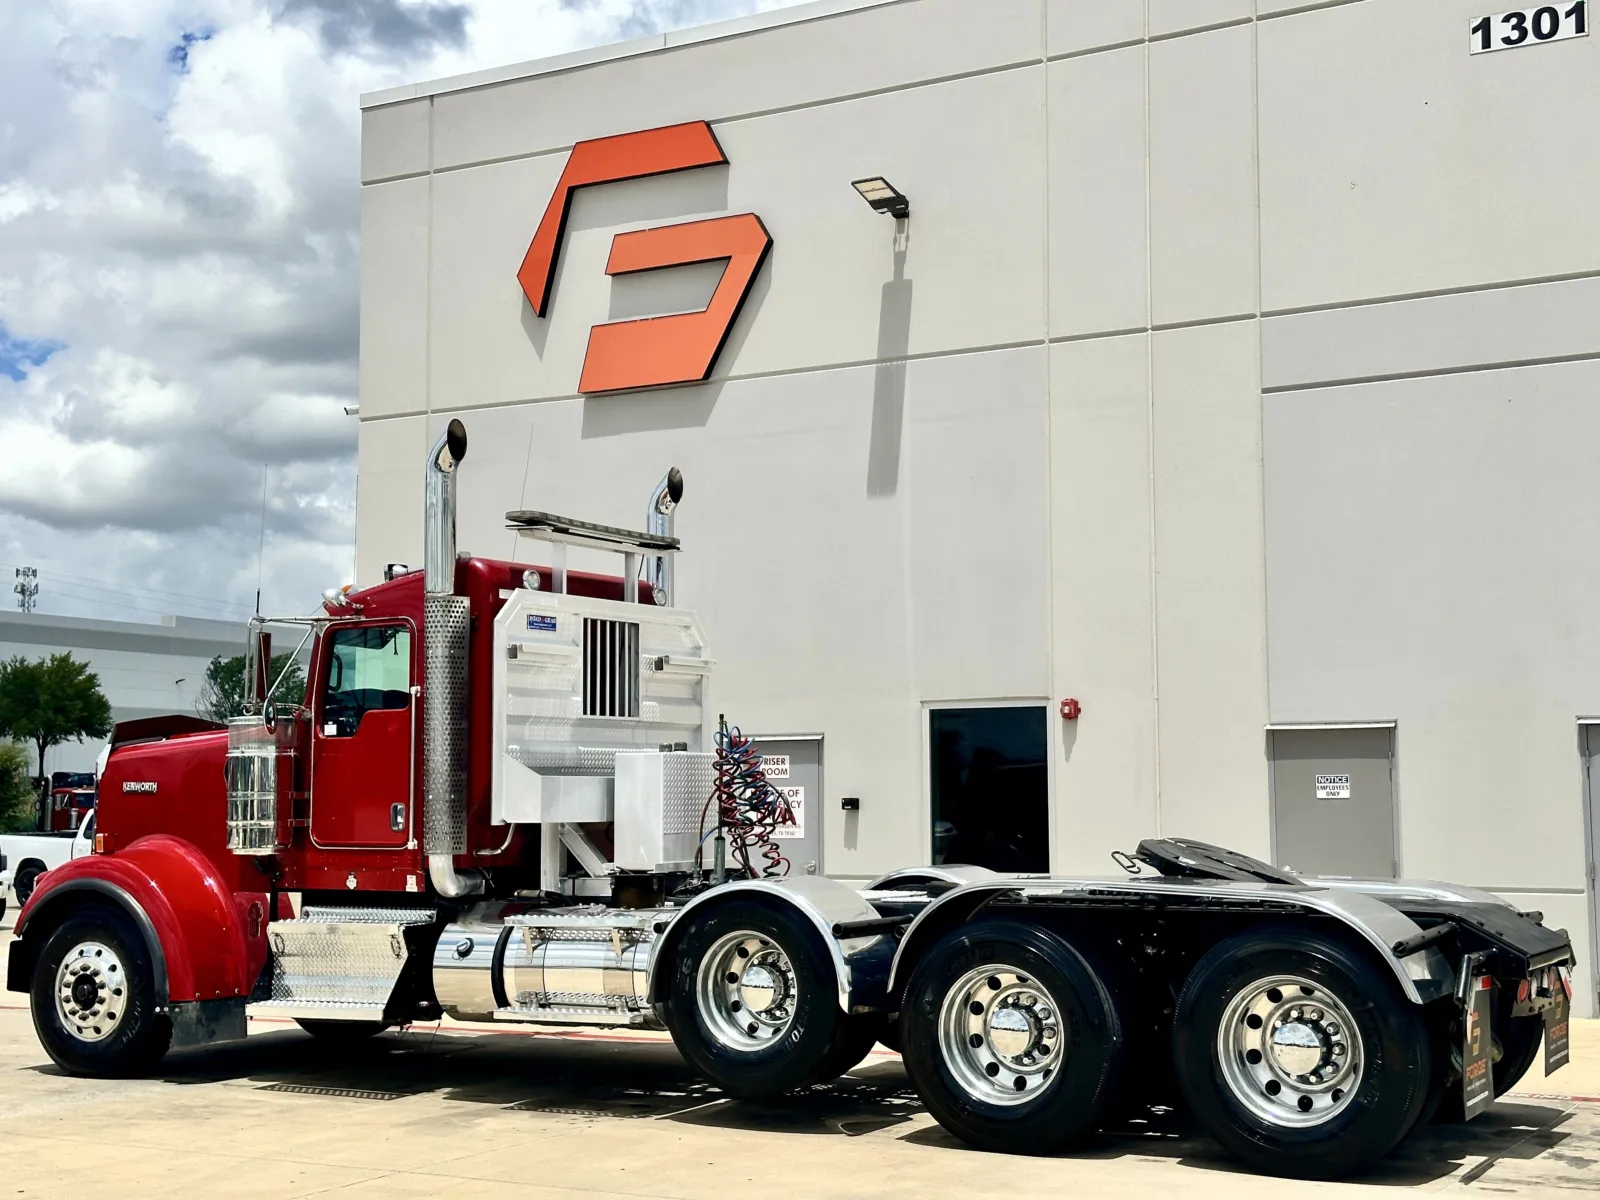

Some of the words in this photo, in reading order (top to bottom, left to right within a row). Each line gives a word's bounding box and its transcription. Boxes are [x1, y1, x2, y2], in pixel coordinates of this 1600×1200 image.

[1472, 0, 1585, 50] 1301
[763, 758, 786, 766] RISER
[122, 781, 158, 793] KENWORTH
[788, 790, 800, 798] OF
